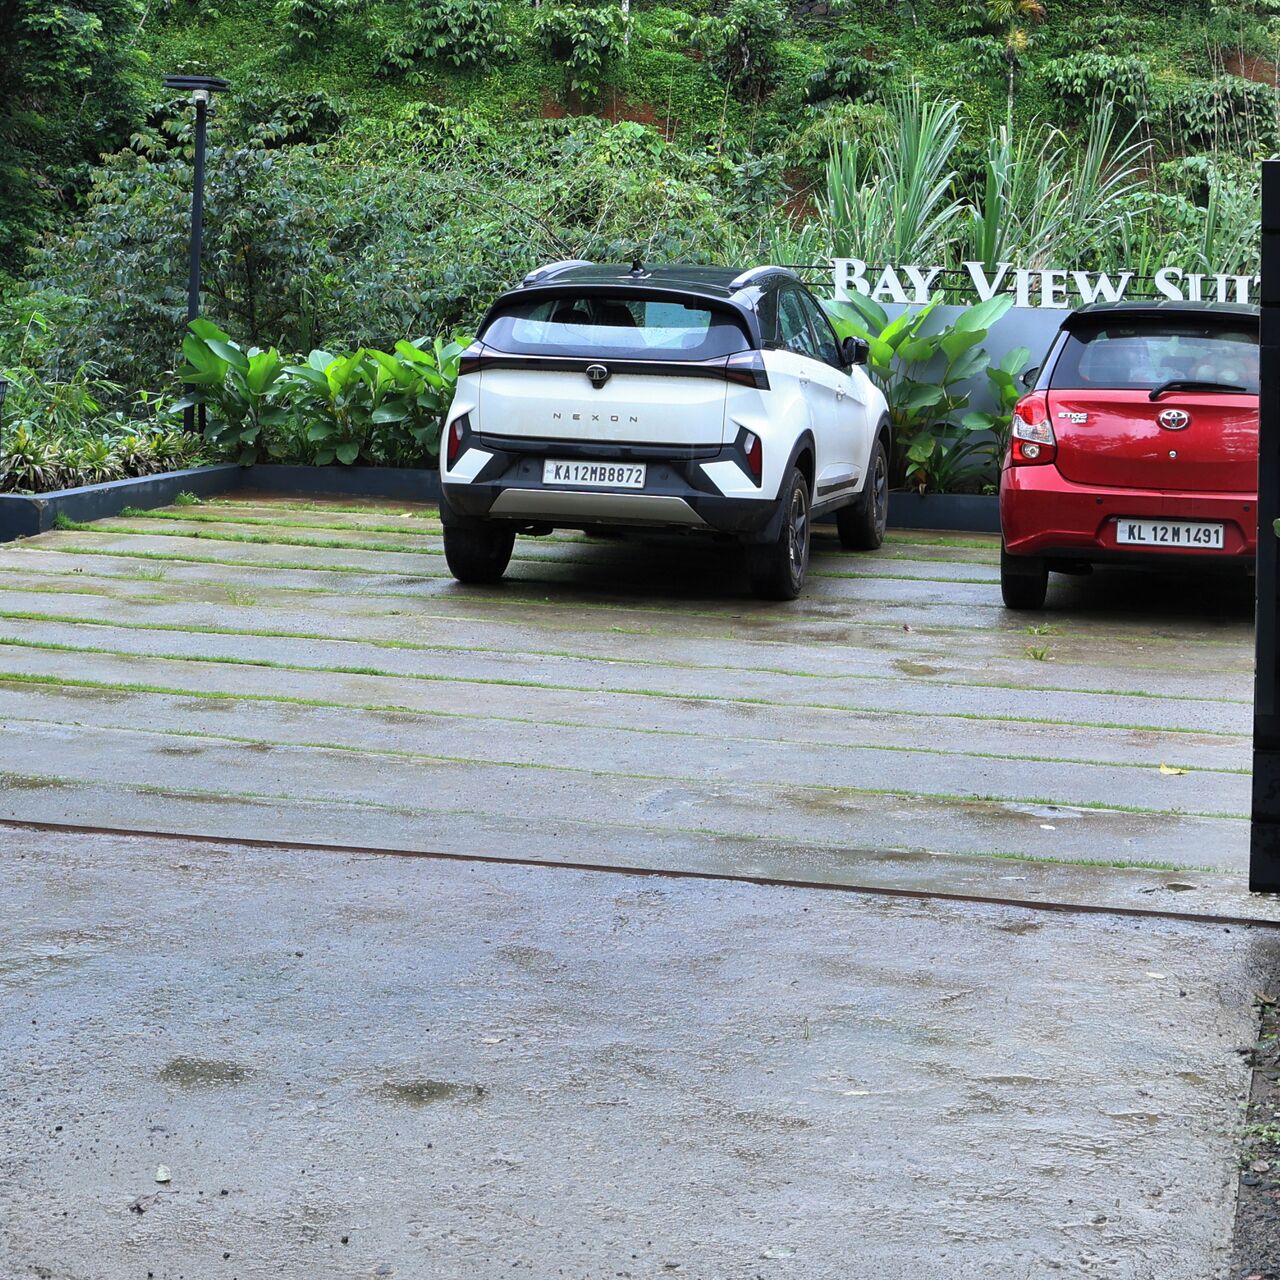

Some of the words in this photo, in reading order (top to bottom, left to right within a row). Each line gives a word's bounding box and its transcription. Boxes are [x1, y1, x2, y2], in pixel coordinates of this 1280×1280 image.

[831, 257, 945, 305] BAY
[962, 261, 1135, 309] VIEW
[553, 412, 638, 423] NEXON
[554, 464, 643, 484] KA12MB8872
